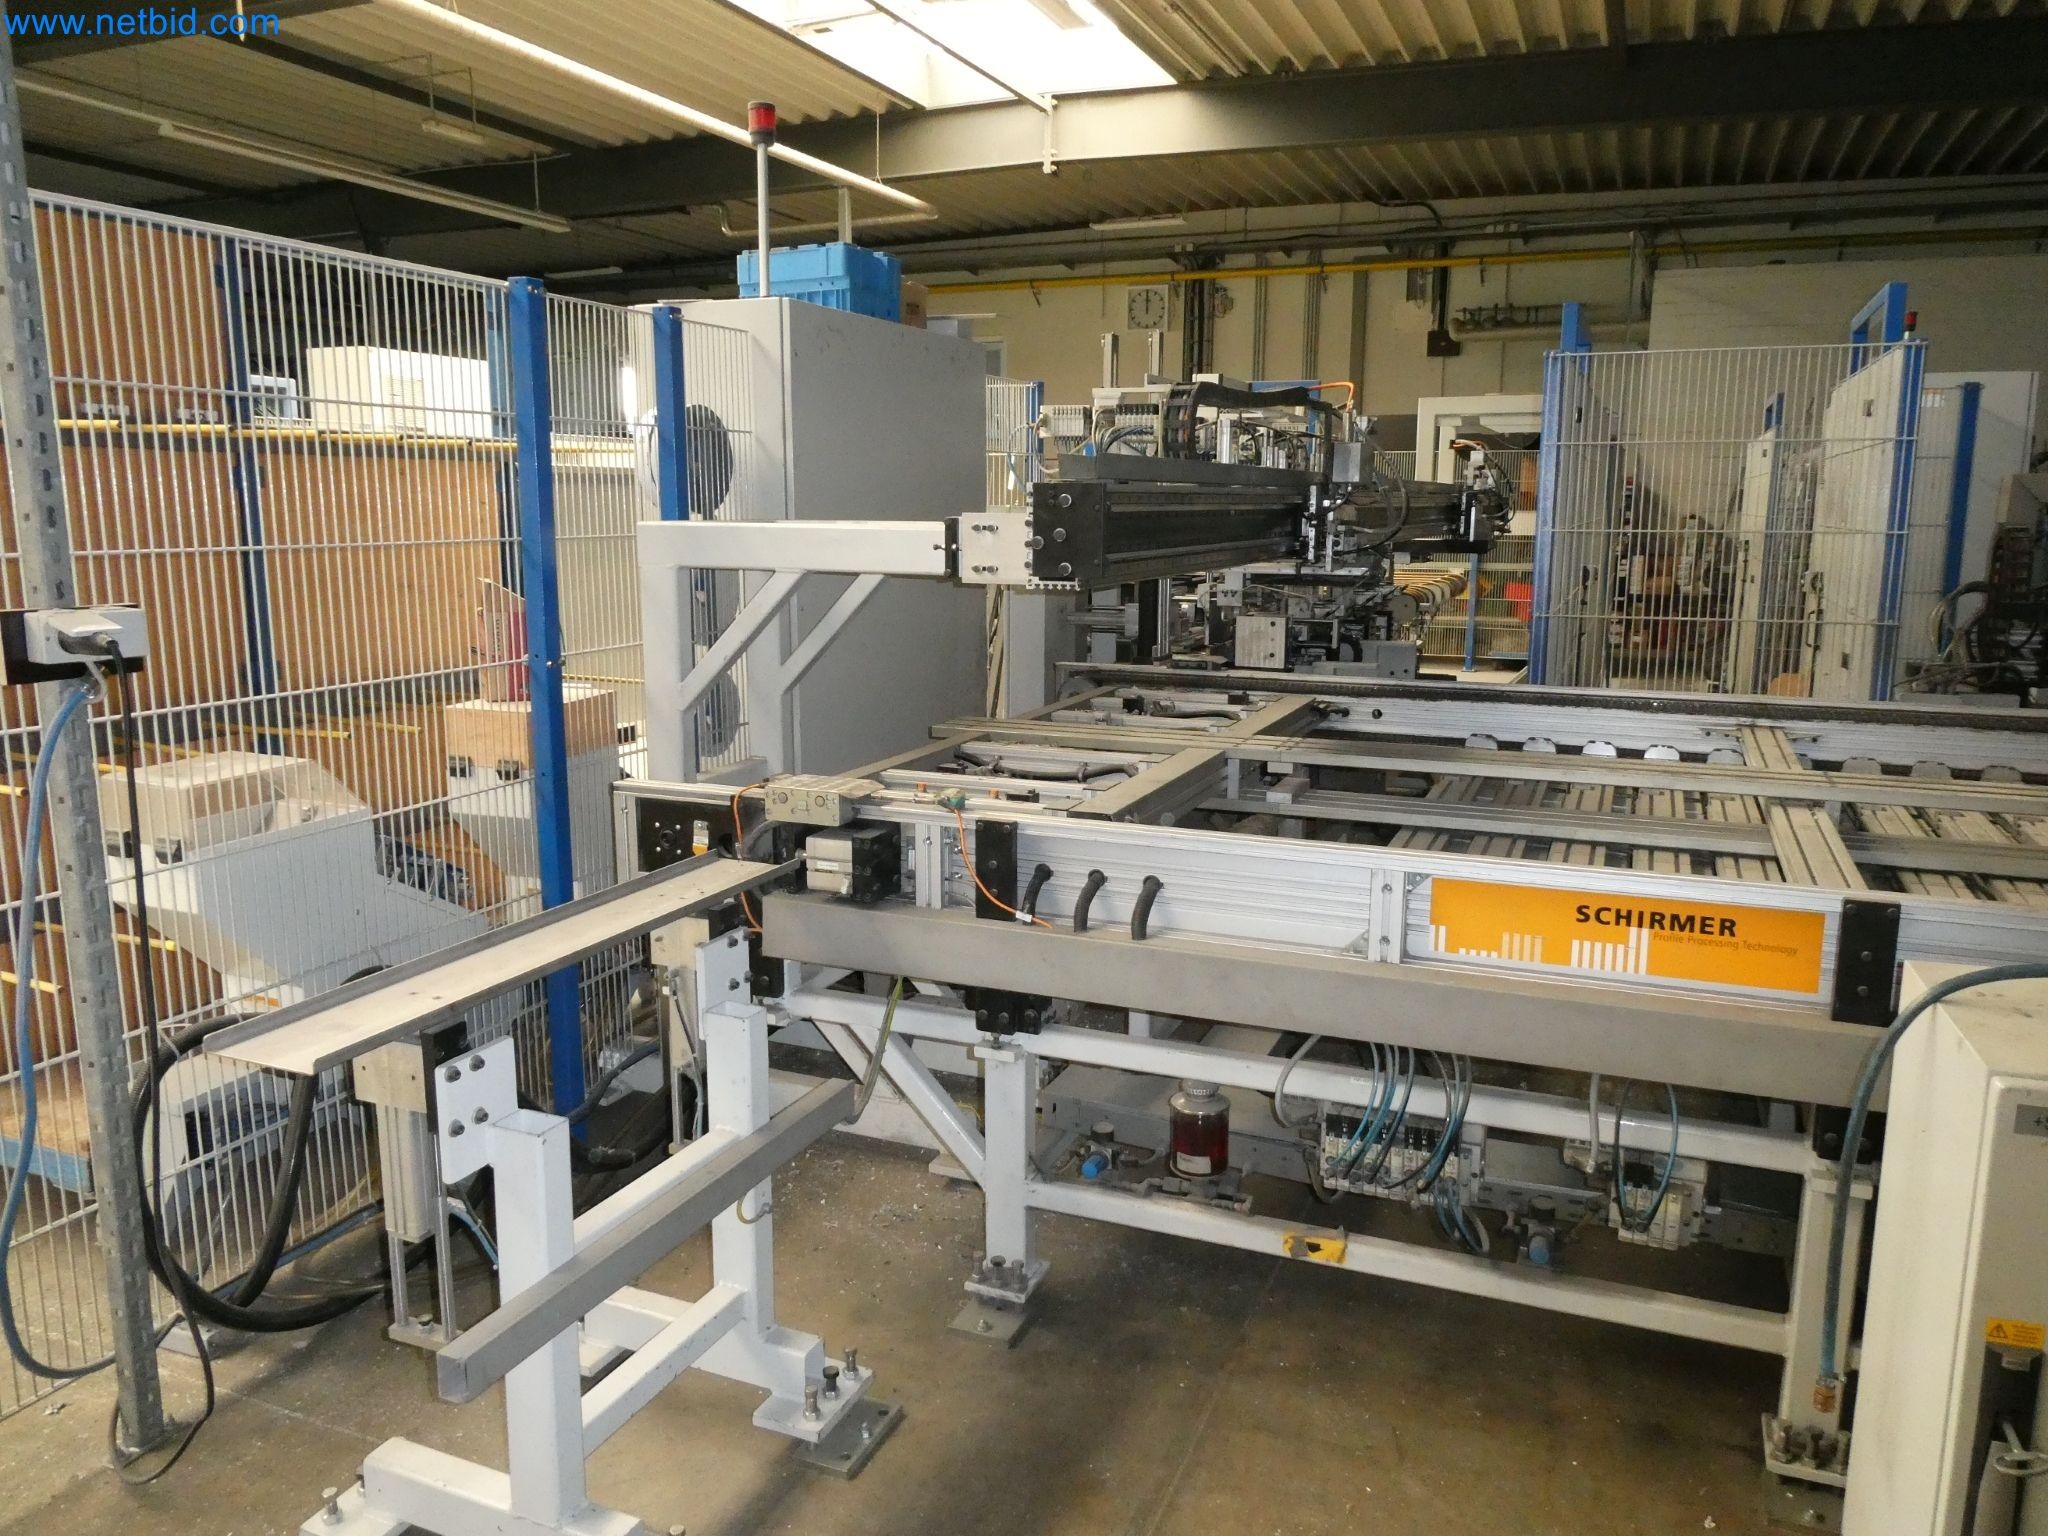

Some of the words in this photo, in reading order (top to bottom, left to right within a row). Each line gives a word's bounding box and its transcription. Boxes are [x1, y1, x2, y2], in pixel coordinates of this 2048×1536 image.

[1575, 904, 1737, 937] SCHIRMER
[1653, 931, 1684, 944] Profile
[1687, 935, 1740, 950] Processing
[1742, 940, 1799, 956] Technology
